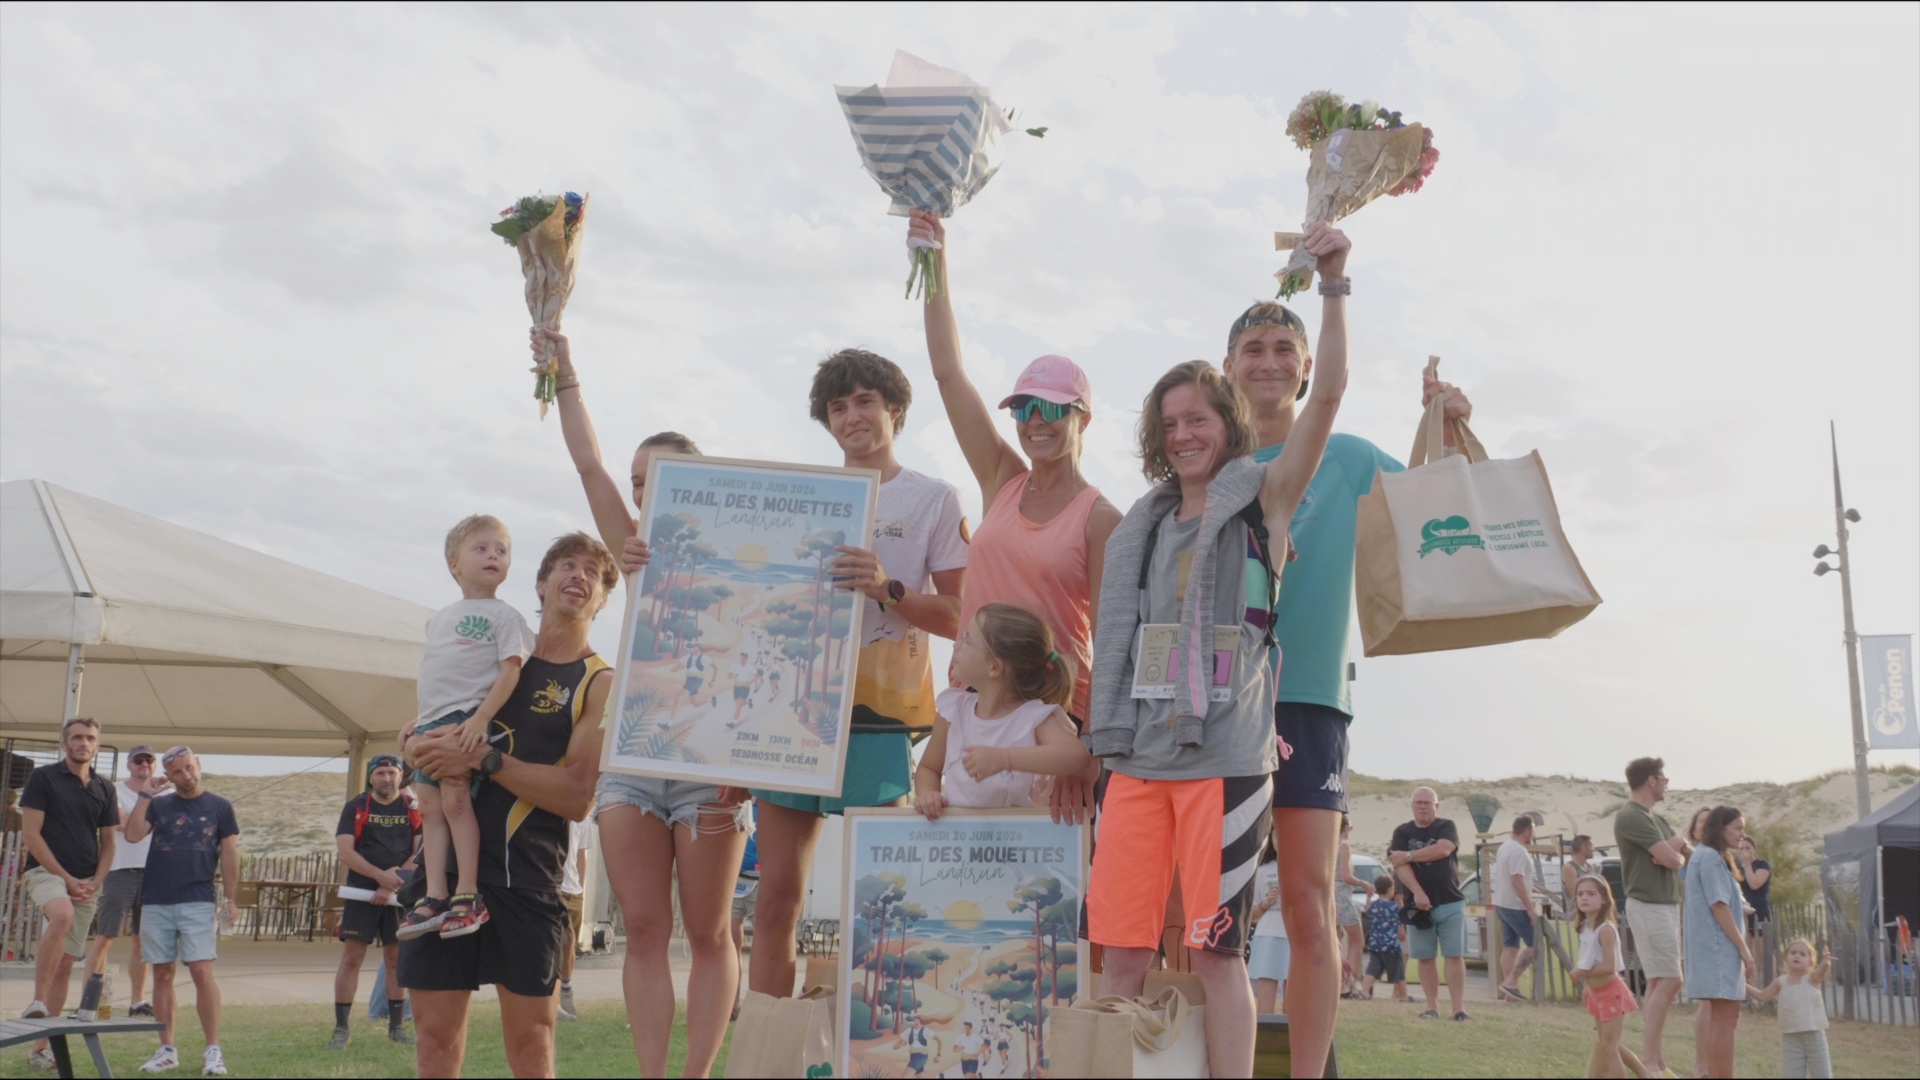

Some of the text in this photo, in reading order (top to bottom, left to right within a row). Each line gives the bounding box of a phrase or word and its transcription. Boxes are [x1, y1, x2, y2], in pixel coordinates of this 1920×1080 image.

[707, 476, 816, 495] SAMEDI 20 JUIN 2026
[670, 488, 853, 518] TRAIL DES MOUETTES
[769, 735, 791, 746] 13KM
[731, 749, 818, 766] SEIGNOSSE OCÉAN
[908, 830, 1023, 842] SAMEDI 20 JUIN 2026
[870, 845, 1065, 864] TRAIL DES MOUETTES
